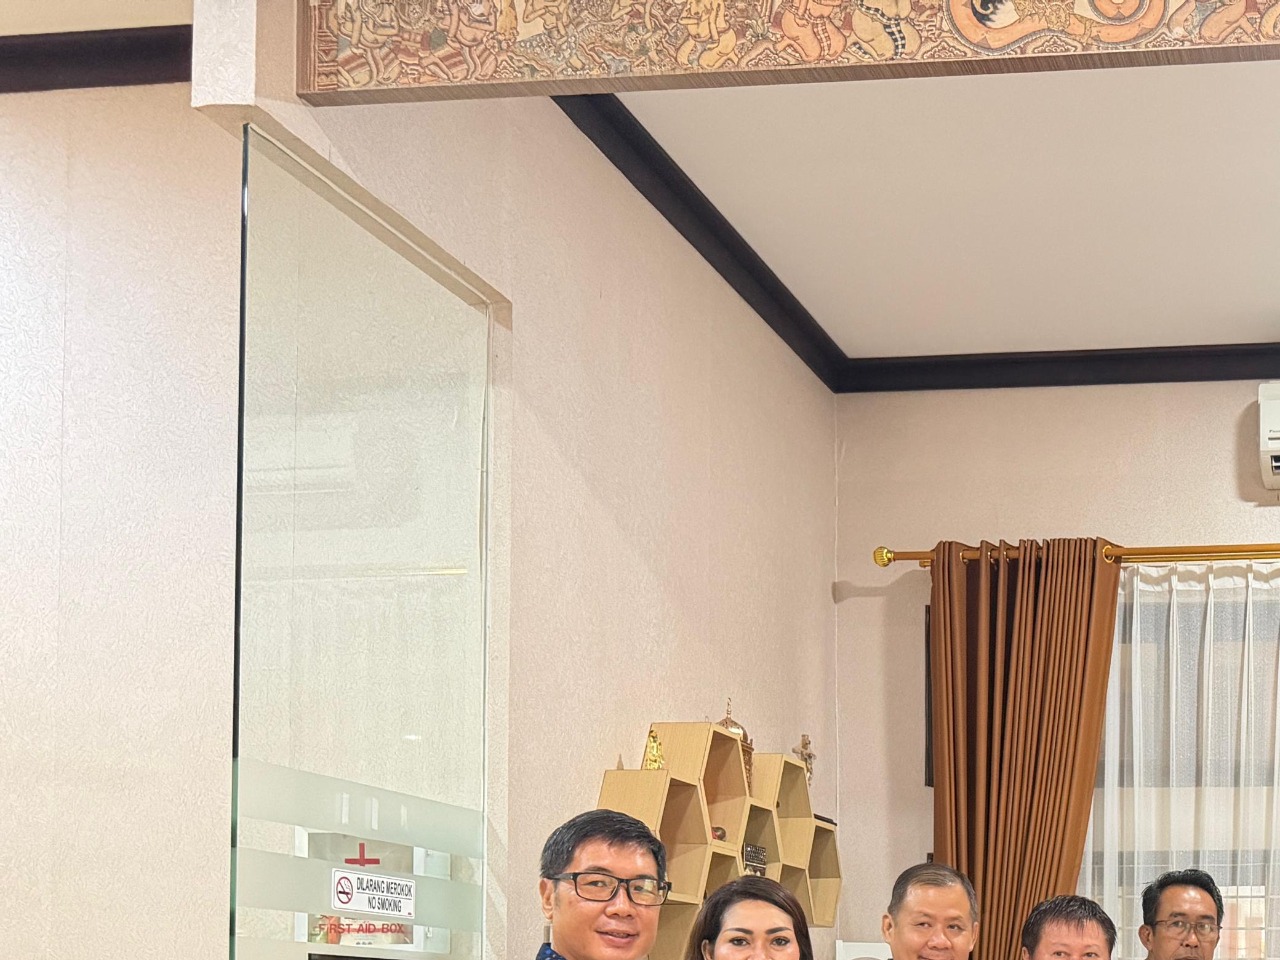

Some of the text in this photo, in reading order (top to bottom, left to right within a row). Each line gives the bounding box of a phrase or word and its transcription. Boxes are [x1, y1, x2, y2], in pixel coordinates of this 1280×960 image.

[357, 877, 412, 897] DILARANG MEROKOK
[367, 896, 402, 912] NO SMOKING
[319, 923, 404, 934] FRST AID BOX
